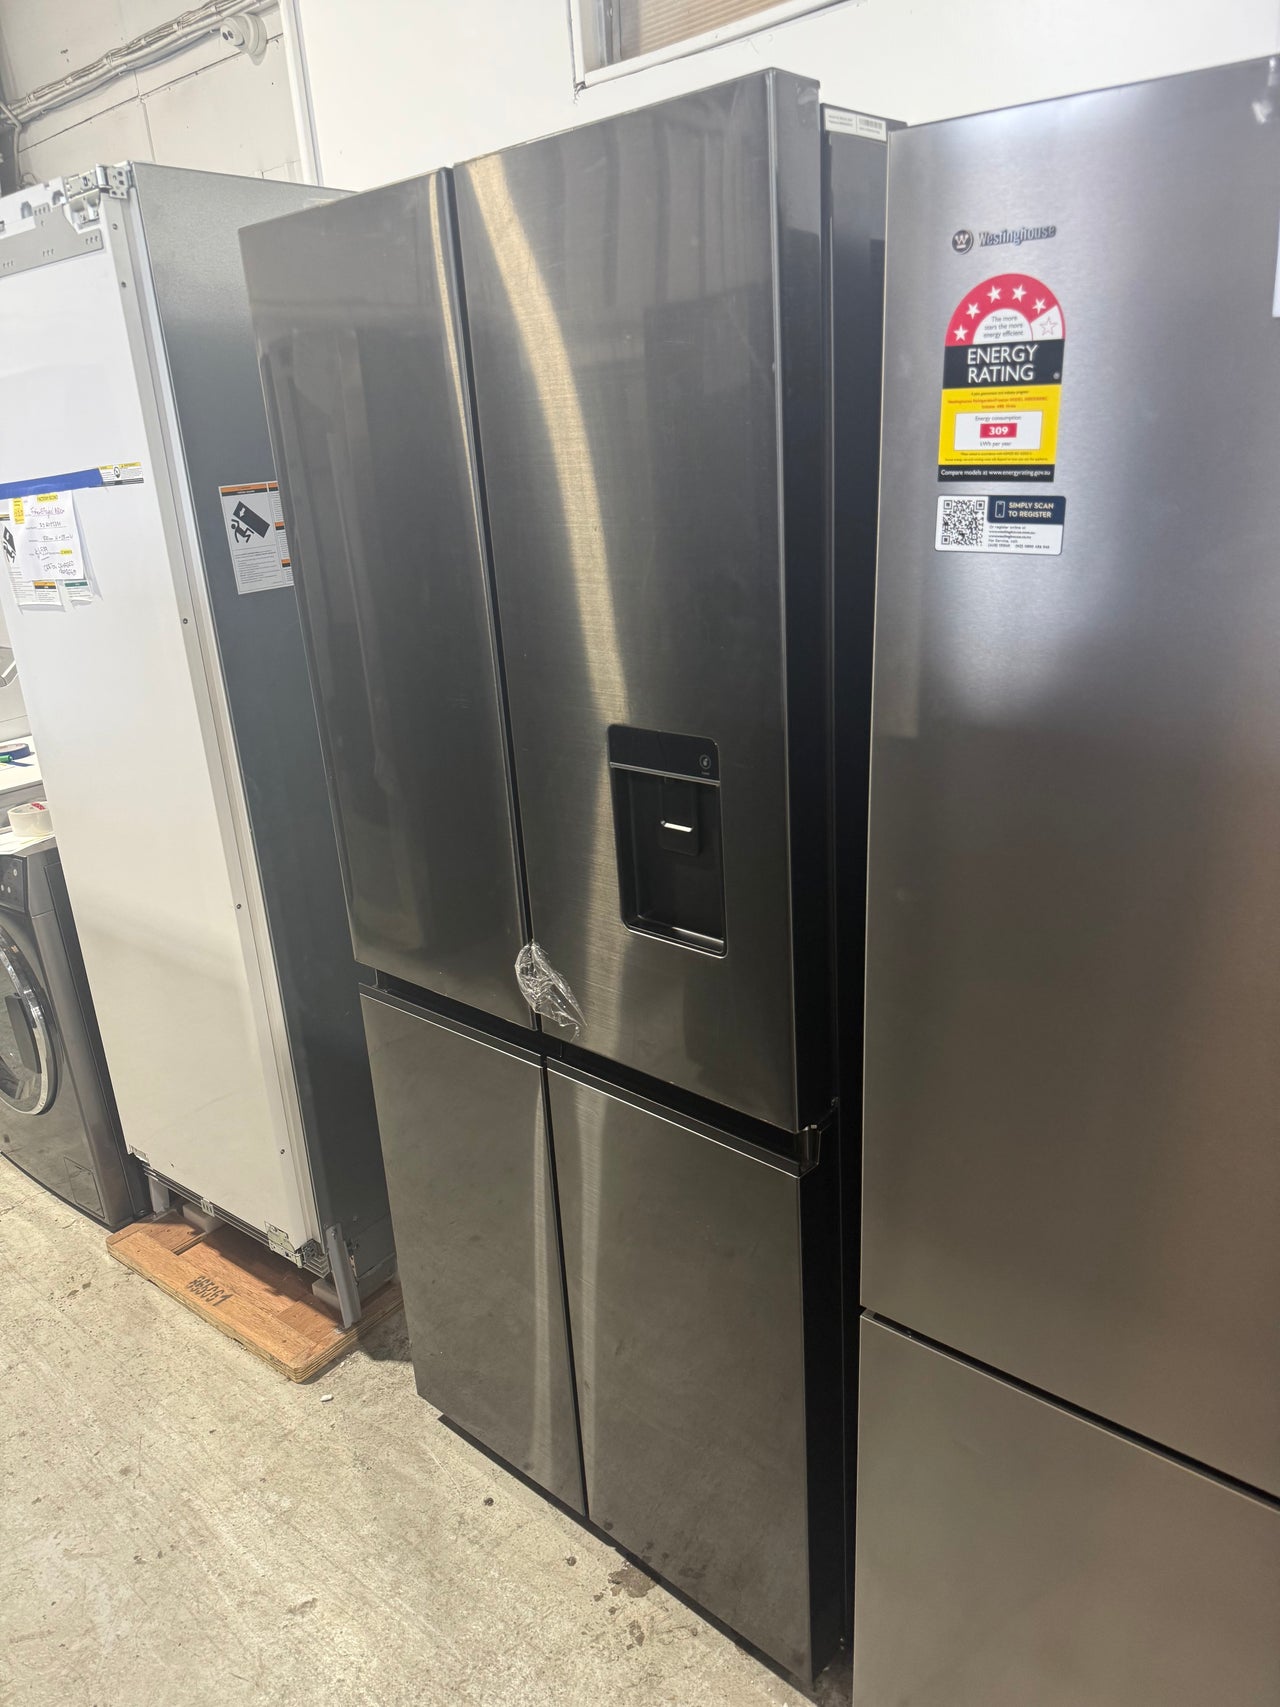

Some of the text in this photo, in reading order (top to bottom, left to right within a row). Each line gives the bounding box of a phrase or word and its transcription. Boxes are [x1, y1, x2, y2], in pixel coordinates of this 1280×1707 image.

[978, 225, 1057, 247] Westinghouse
[983, 331, 1001, 339] energy
[967, 344, 1039, 365] ENERGY
[968, 364, 1034, 383] RATING
[989, 426, 1009, 436] 309
[940, 469, 963, 477] Compare
[988, 469, 1051, 478] www.energyrating.gov.au
[1033, 502, 1055, 510] SCAN
